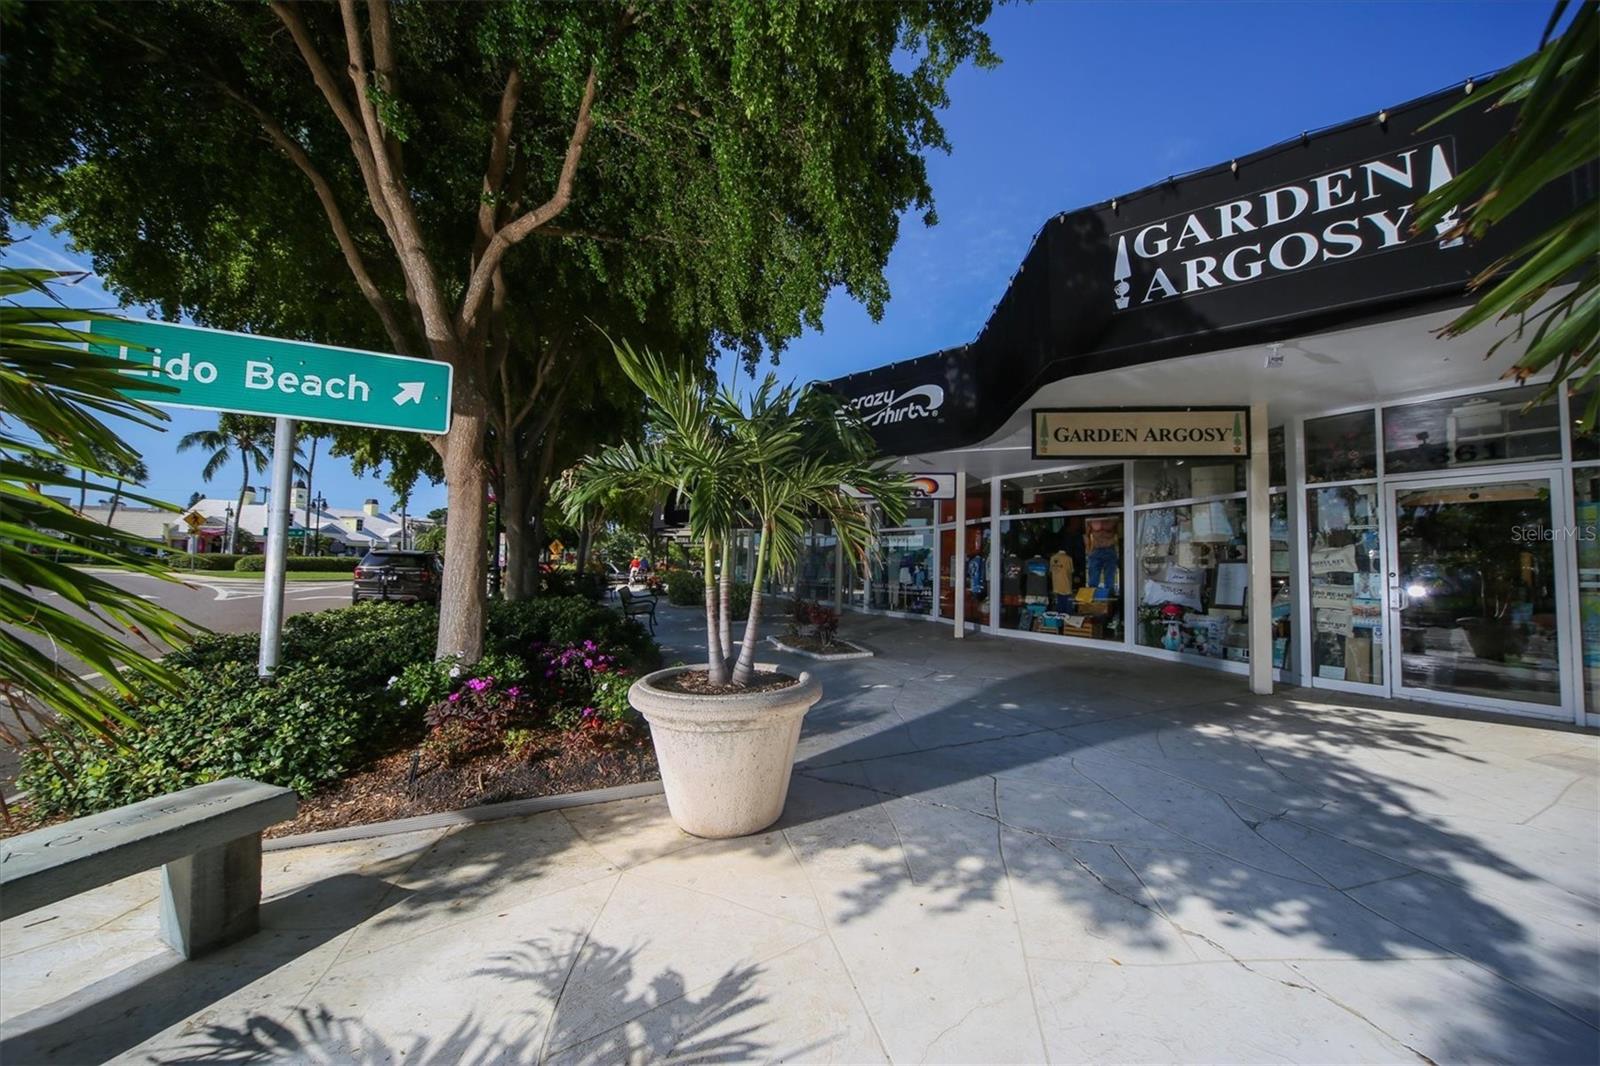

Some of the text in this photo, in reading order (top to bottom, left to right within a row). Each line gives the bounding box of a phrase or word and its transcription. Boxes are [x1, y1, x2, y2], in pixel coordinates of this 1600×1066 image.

[1134, 149, 1418, 258] GARDEN
[1141, 208, 1413, 304] ARGOSY
[118, 346, 370, 402] Lido Beach
[851, 389, 895, 410] crazy
[1053, 426, 1228, 443] GARDEN ARGOSY
